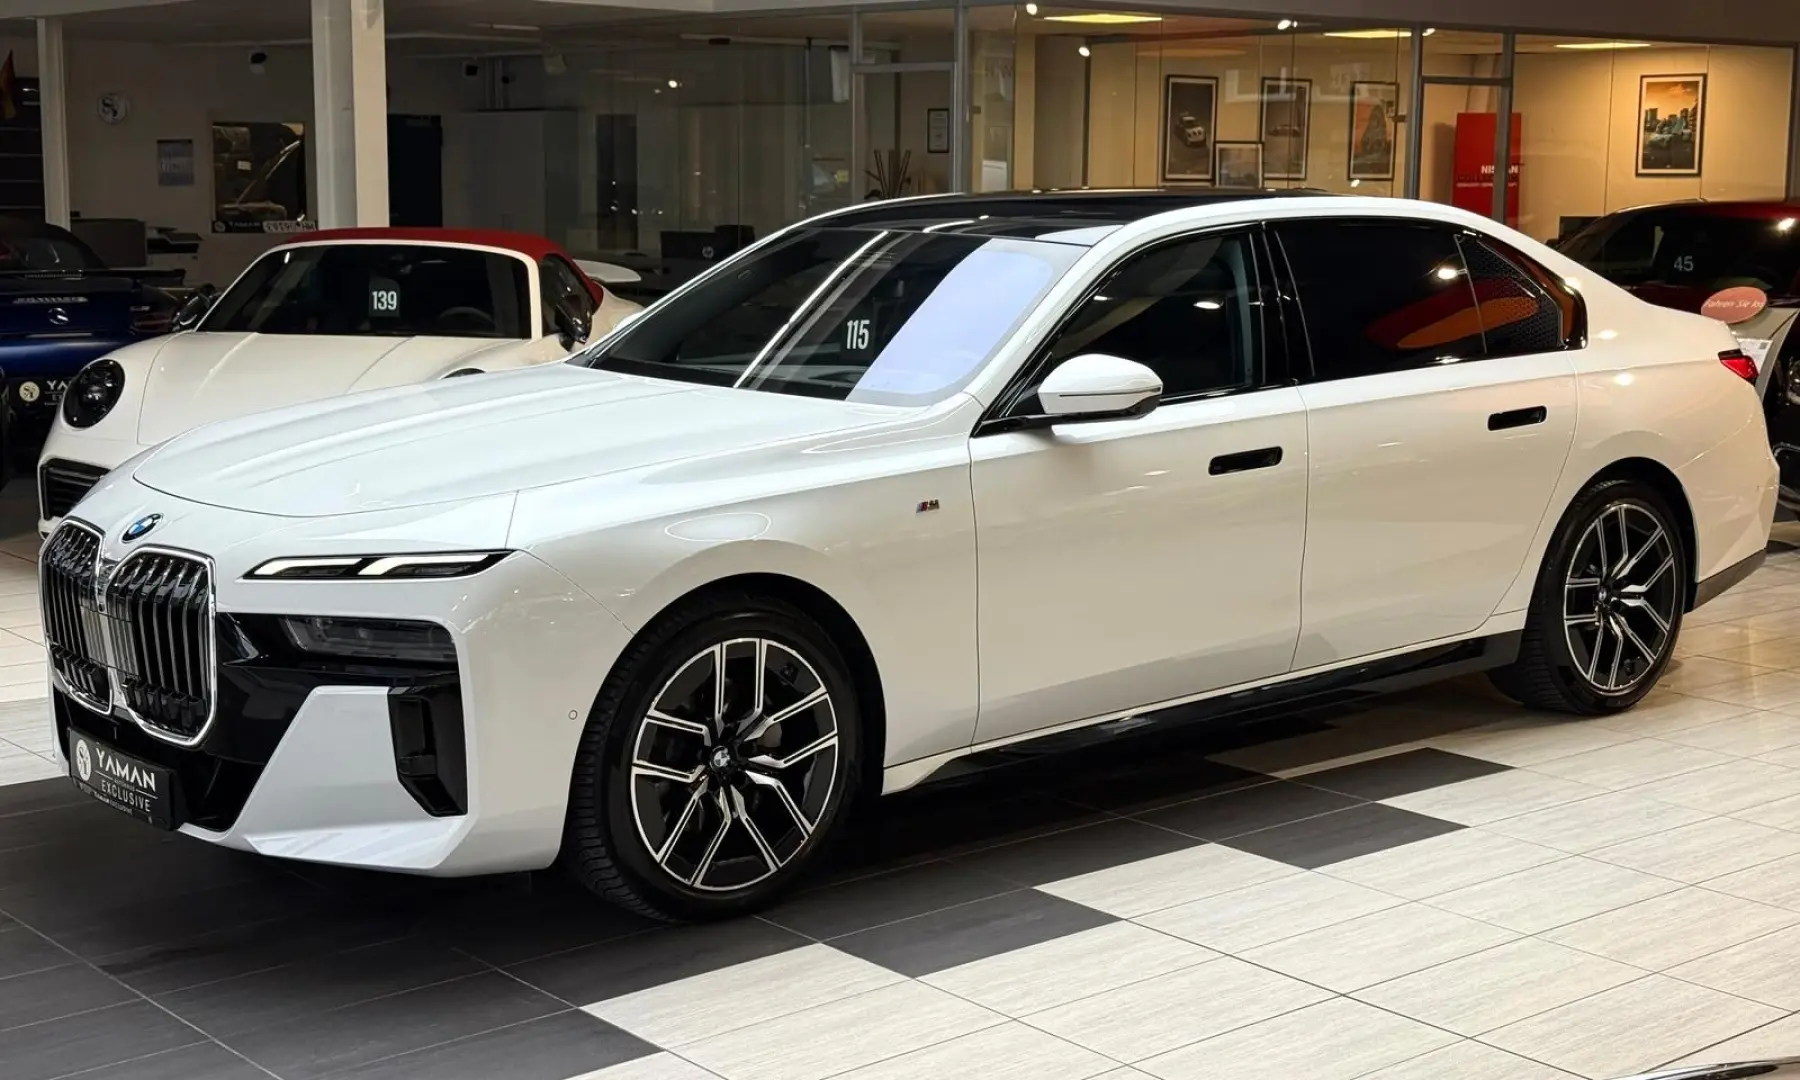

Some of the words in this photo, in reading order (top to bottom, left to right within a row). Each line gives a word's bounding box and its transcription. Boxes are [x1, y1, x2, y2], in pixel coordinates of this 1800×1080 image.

[1674, 256, 1694, 272] 45
[372, 290, 397, 310] 139
[847, 319, 870, 350] 115
[96, 747, 156, 792] YAMAN
[101, 779, 151, 812] EXCLUSIVE
